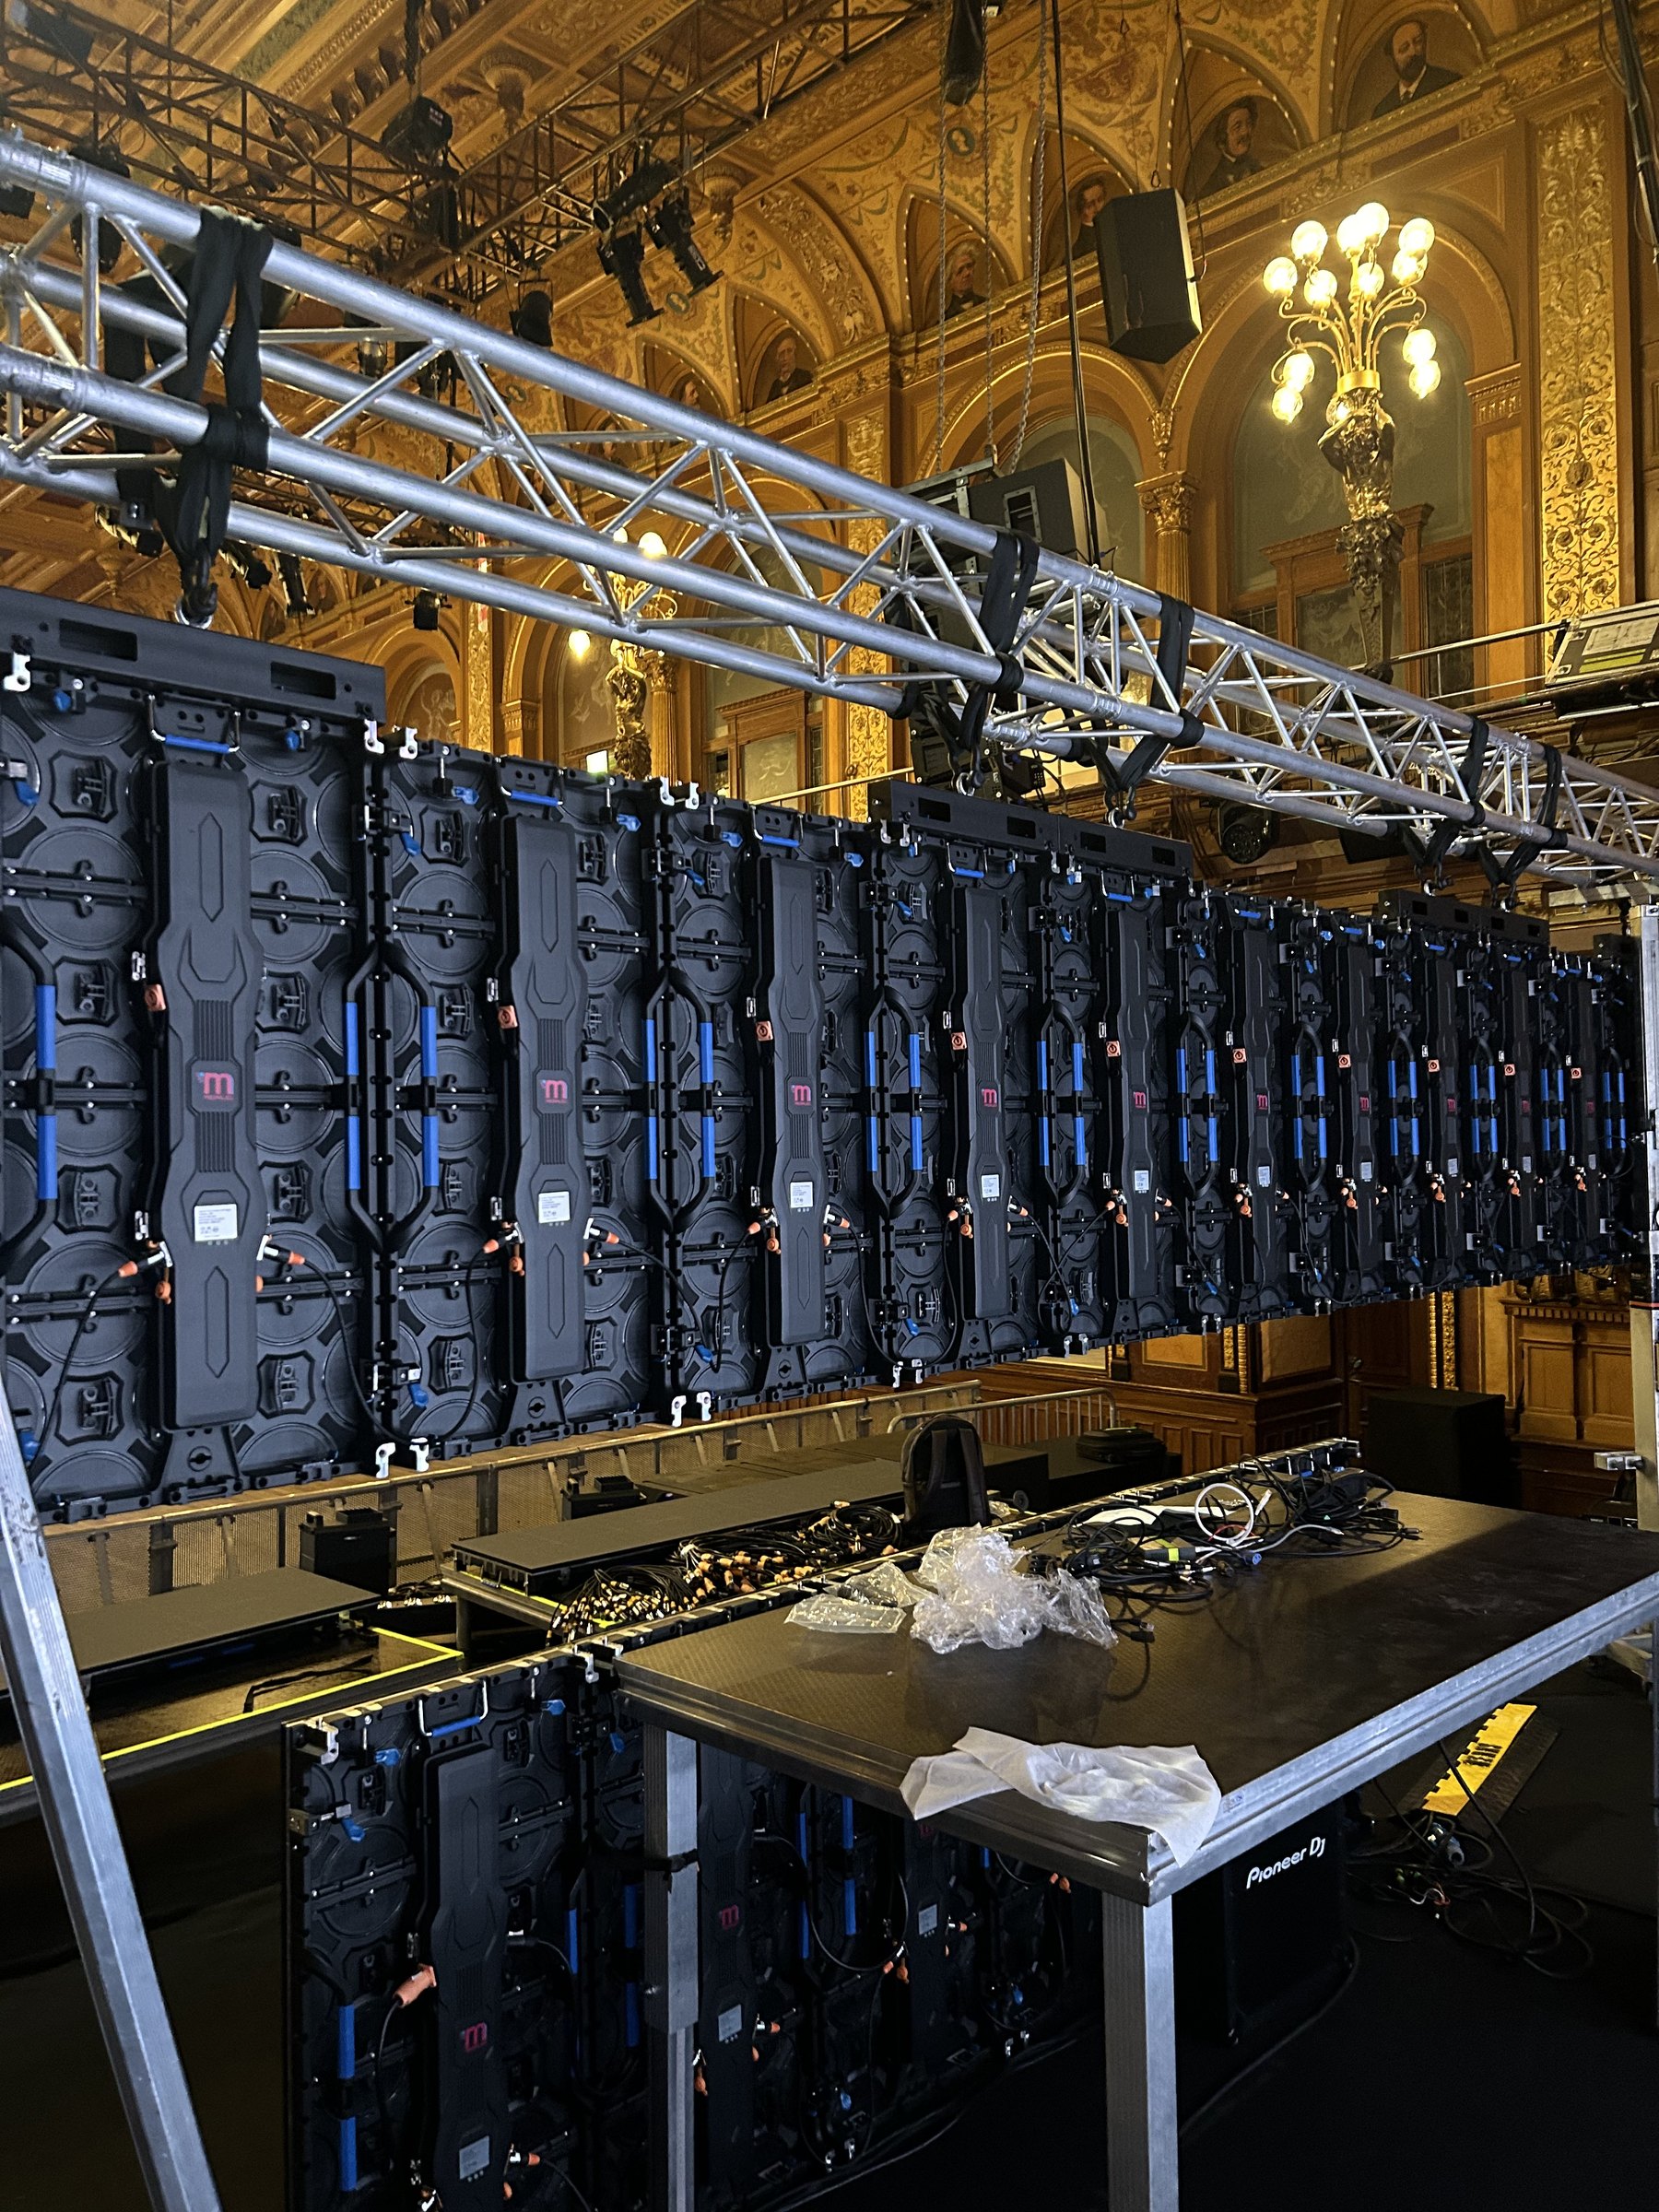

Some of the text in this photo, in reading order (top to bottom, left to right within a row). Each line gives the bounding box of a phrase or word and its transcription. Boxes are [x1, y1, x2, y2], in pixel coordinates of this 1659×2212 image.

[204, 1072, 234, 1094] m
[546, 1080, 567, 1099] m
[1246, 1836, 1325, 1889] Pioneer DJ
